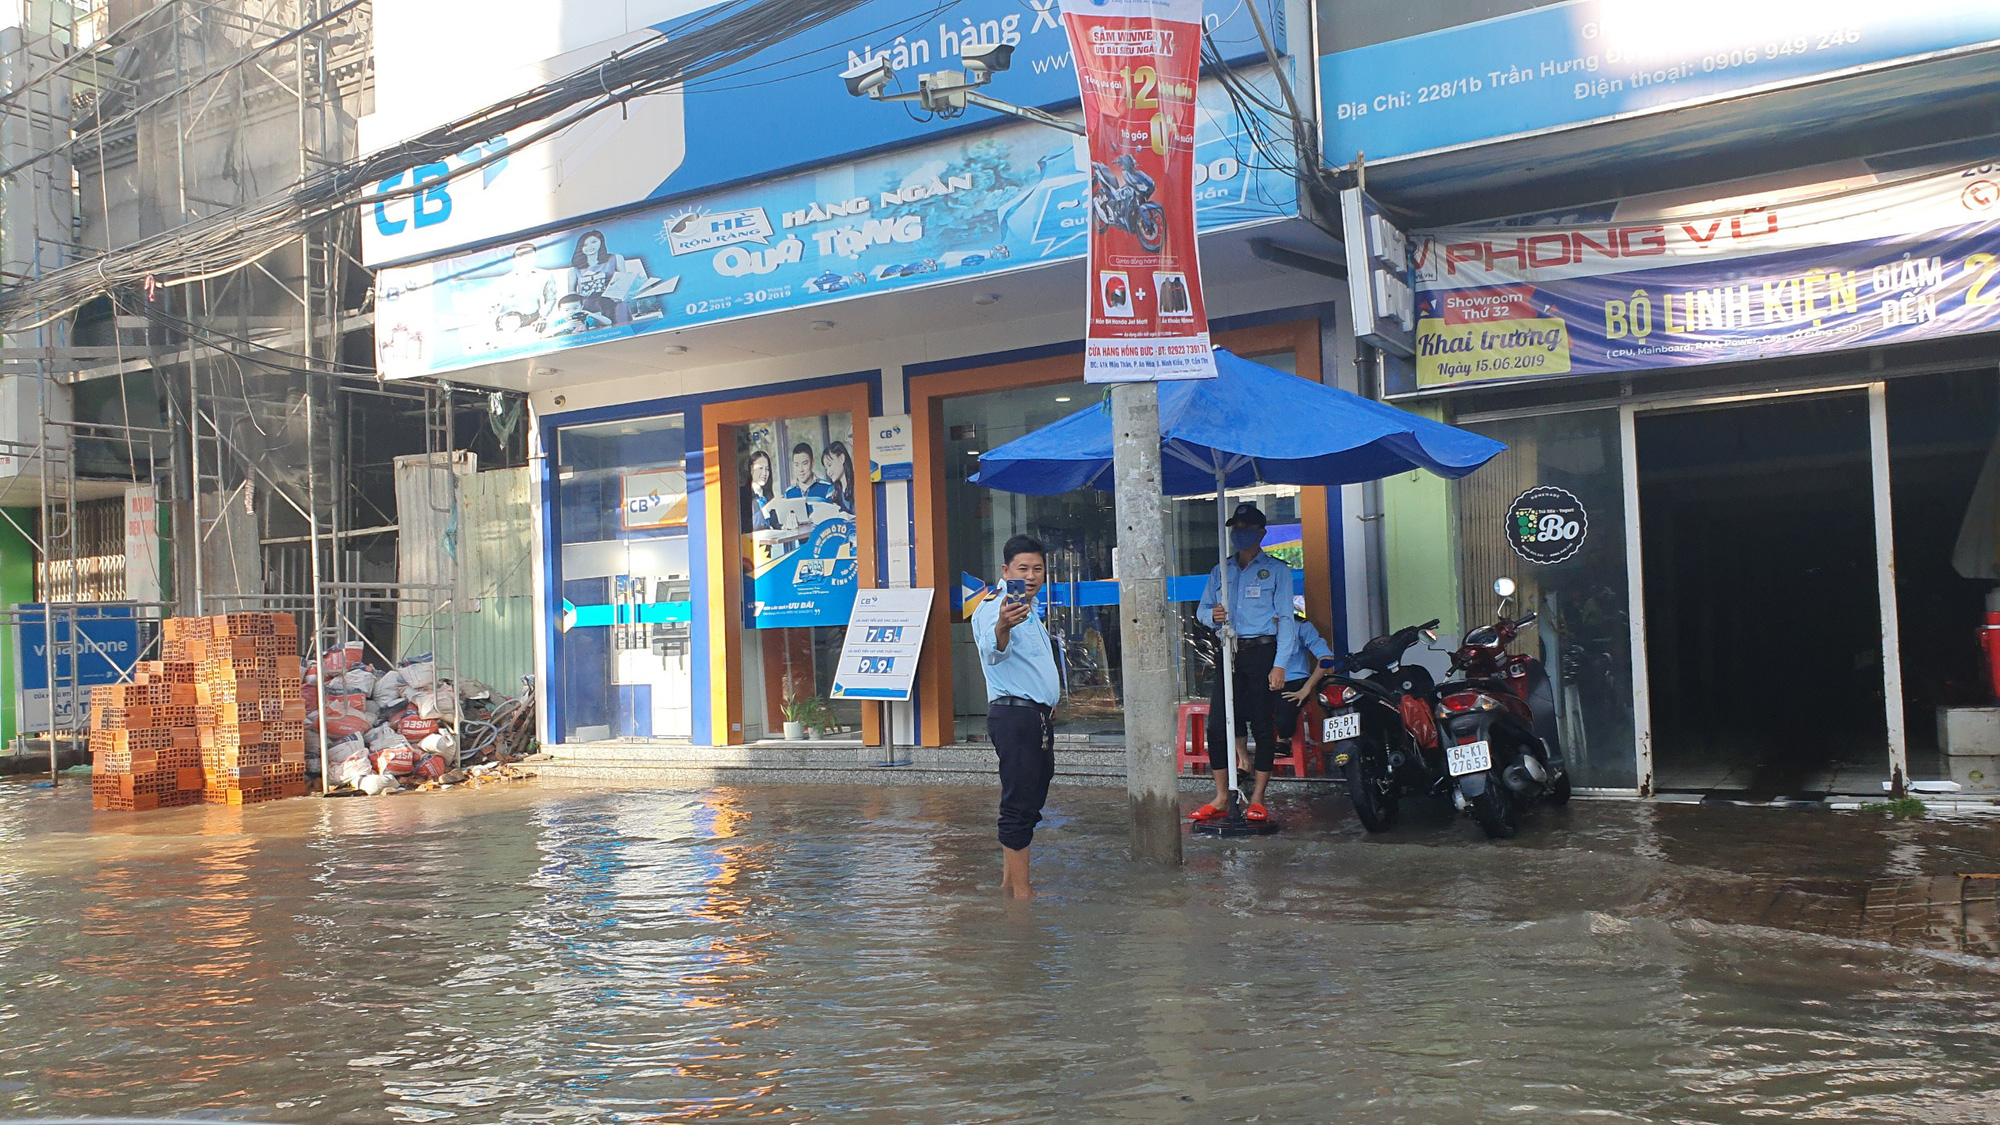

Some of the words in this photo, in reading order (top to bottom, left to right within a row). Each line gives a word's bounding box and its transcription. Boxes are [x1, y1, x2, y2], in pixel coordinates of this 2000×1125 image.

[1159, 32, 1173, 55] X
[1574, 76, 1623, 100] Điện
[1630, 61, 1693, 90] thoại:
[1702, 48, 1758, 73] 0906
[1764, 38, 1808, 60] 949
[1120, 66, 1158, 109] 12
[1337, 101, 1368, 121] Địa
[1373, 91, 1411, 113] Chỉ:
[1417, 77, 1482, 104] 228/1b
[1488, 64, 1534, 88] Trần
[1540, 52, 1600, 78] Hưng
[1131, 130, 1148, 142] góp
[374, 161, 453, 236] CB
[782, 199, 871, 229] HÀNG
[880, 172, 973, 208] NGÀN
[711, 212, 757, 233] HÈ
[1445, 225, 1666, 275] PHONG
[1681, 207, 1778, 249] VŨ
[743, 289, 767, 305] 30
[767, 290, 791, 301] 2019
[1446, 293, 1523, 308] Showroom
[1604, 288, 1653, 345] BỘ
[1663, 284, 1750, 334] LINH
[1763, 267, 1858, 327] KIỆN
[1872, 252, 1943, 293] GIẢM
[685, 300, 709, 315] 02
[709, 301, 732, 312] 2019
[1462, 306, 1489, 320] Thứ
[1492, 306, 1510, 318] 32
[1881, 287, 1937, 329] ĐẾN
[1088, 344, 1101, 357] CỬA
[1103, 345, 1119, 357] HÀNG
[1418, 331, 1475, 357] Khai
[1480, 328, 1563, 352] trương
[1437, 360, 1473, 378] Ngày
[1475, 354, 1545, 372] 15.06.2019
[879, 429, 893, 439] CB
[629, 498, 649, 513] CB
[1537, 514, 1580, 542] Bo
[404, 720, 431, 729] INSEE
[1328, 716, 1354, 730] 65-B1
[1325, 725, 1358, 741] 916.41
[1453, 745, 1482, 760] 64-K1
[1452, 757, 1488, 774] 276.53
